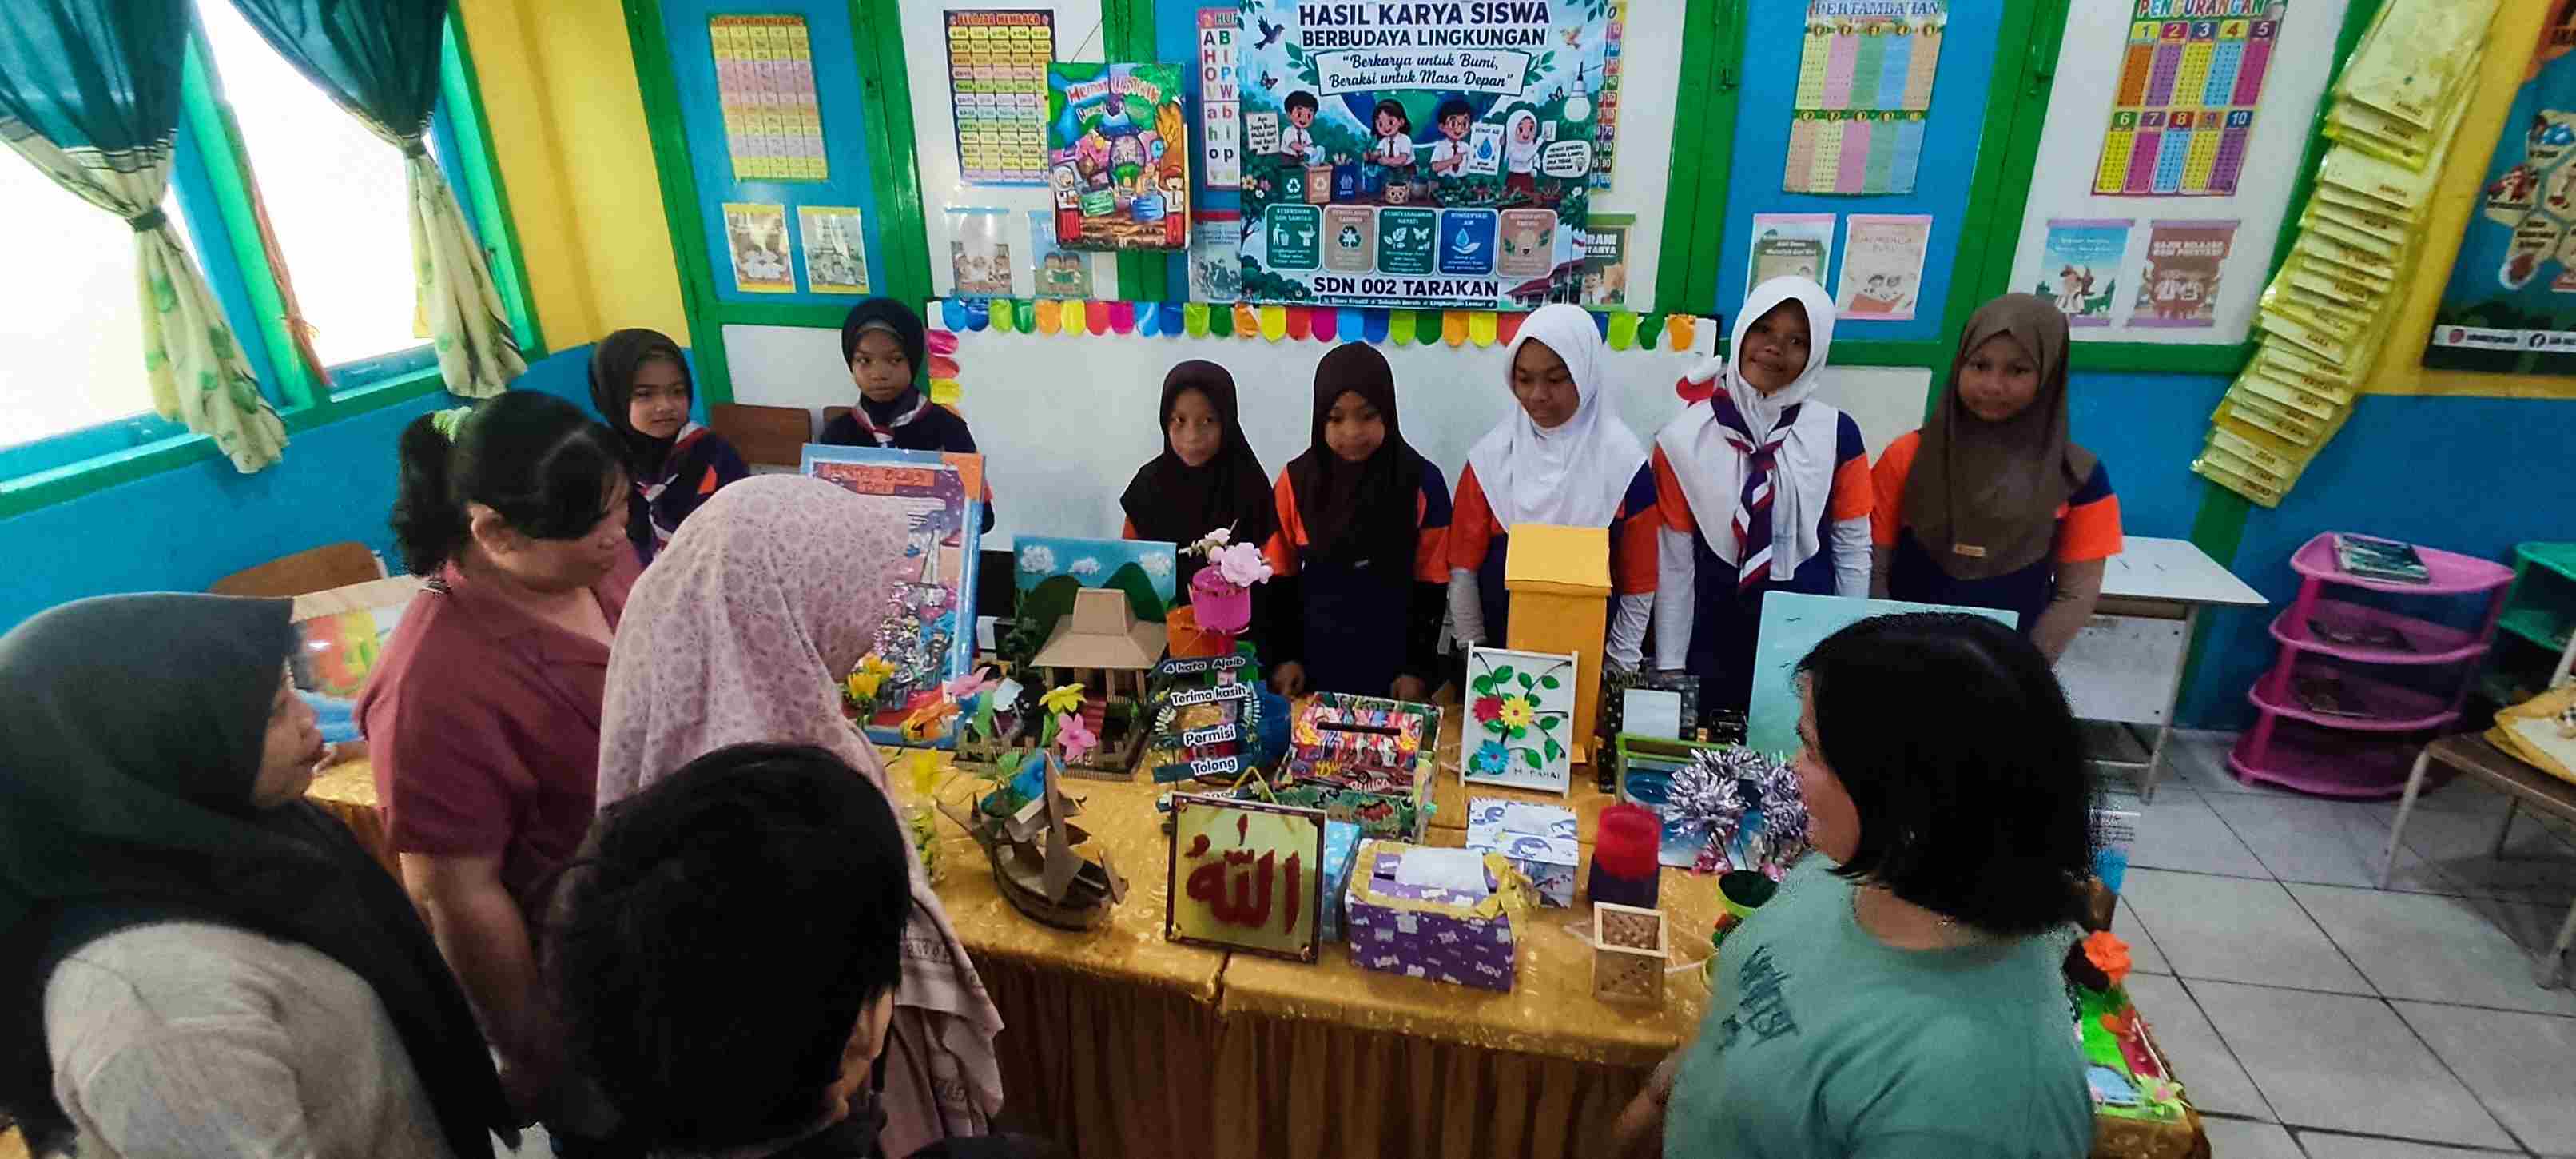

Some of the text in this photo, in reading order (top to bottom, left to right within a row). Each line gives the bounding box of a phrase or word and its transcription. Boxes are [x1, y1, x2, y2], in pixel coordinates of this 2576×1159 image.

[1299, 2, 1550, 26] HASIL KARYA SISWA
[2169, 24, 2180, 35] 2
[2199, 23, 2210, 36] 3
[2226, 22, 2239, 35] 4
[2257, 22, 2270, 35] 5
[1203, 31, 1230, 46] A B
[1302, 29, 1546, 46] BERBUDAYA LINGKUNGAN
[1204, 50, 1216, 63] H
[1417, 56, 1454, 68] untuk
[1459, 54, 1498, 70] Bumi,
[1221, 66, 1232, 80] P
[1329, 73, 1377, 88] Beraksi
[1381, 71, 1415, 85] untuk
[1420, 70, 1458, 84] Masa
[1219, 85, 1233, 98] W
[1207, 103, 1233, 119] a b
[2120, 113, 2130, 125] 6
[2148, 113, 2160, 125] 7
[2232, 112, 2248, 125] 10
[1208, 125, 1218, 141] h
[1209, 147, 1234, 163] o p
[1314, 277, 1498, 297] SDN 002 TARAKAN
[1164, 663, 1175, 674] 4
[1177, 660, 1207, 672] kata
[1172, 685, 1247, 705] Terima kasih
[1185, 725, 1235, 745] Permisi
[1192, 759, 1237, 775] Tolong
